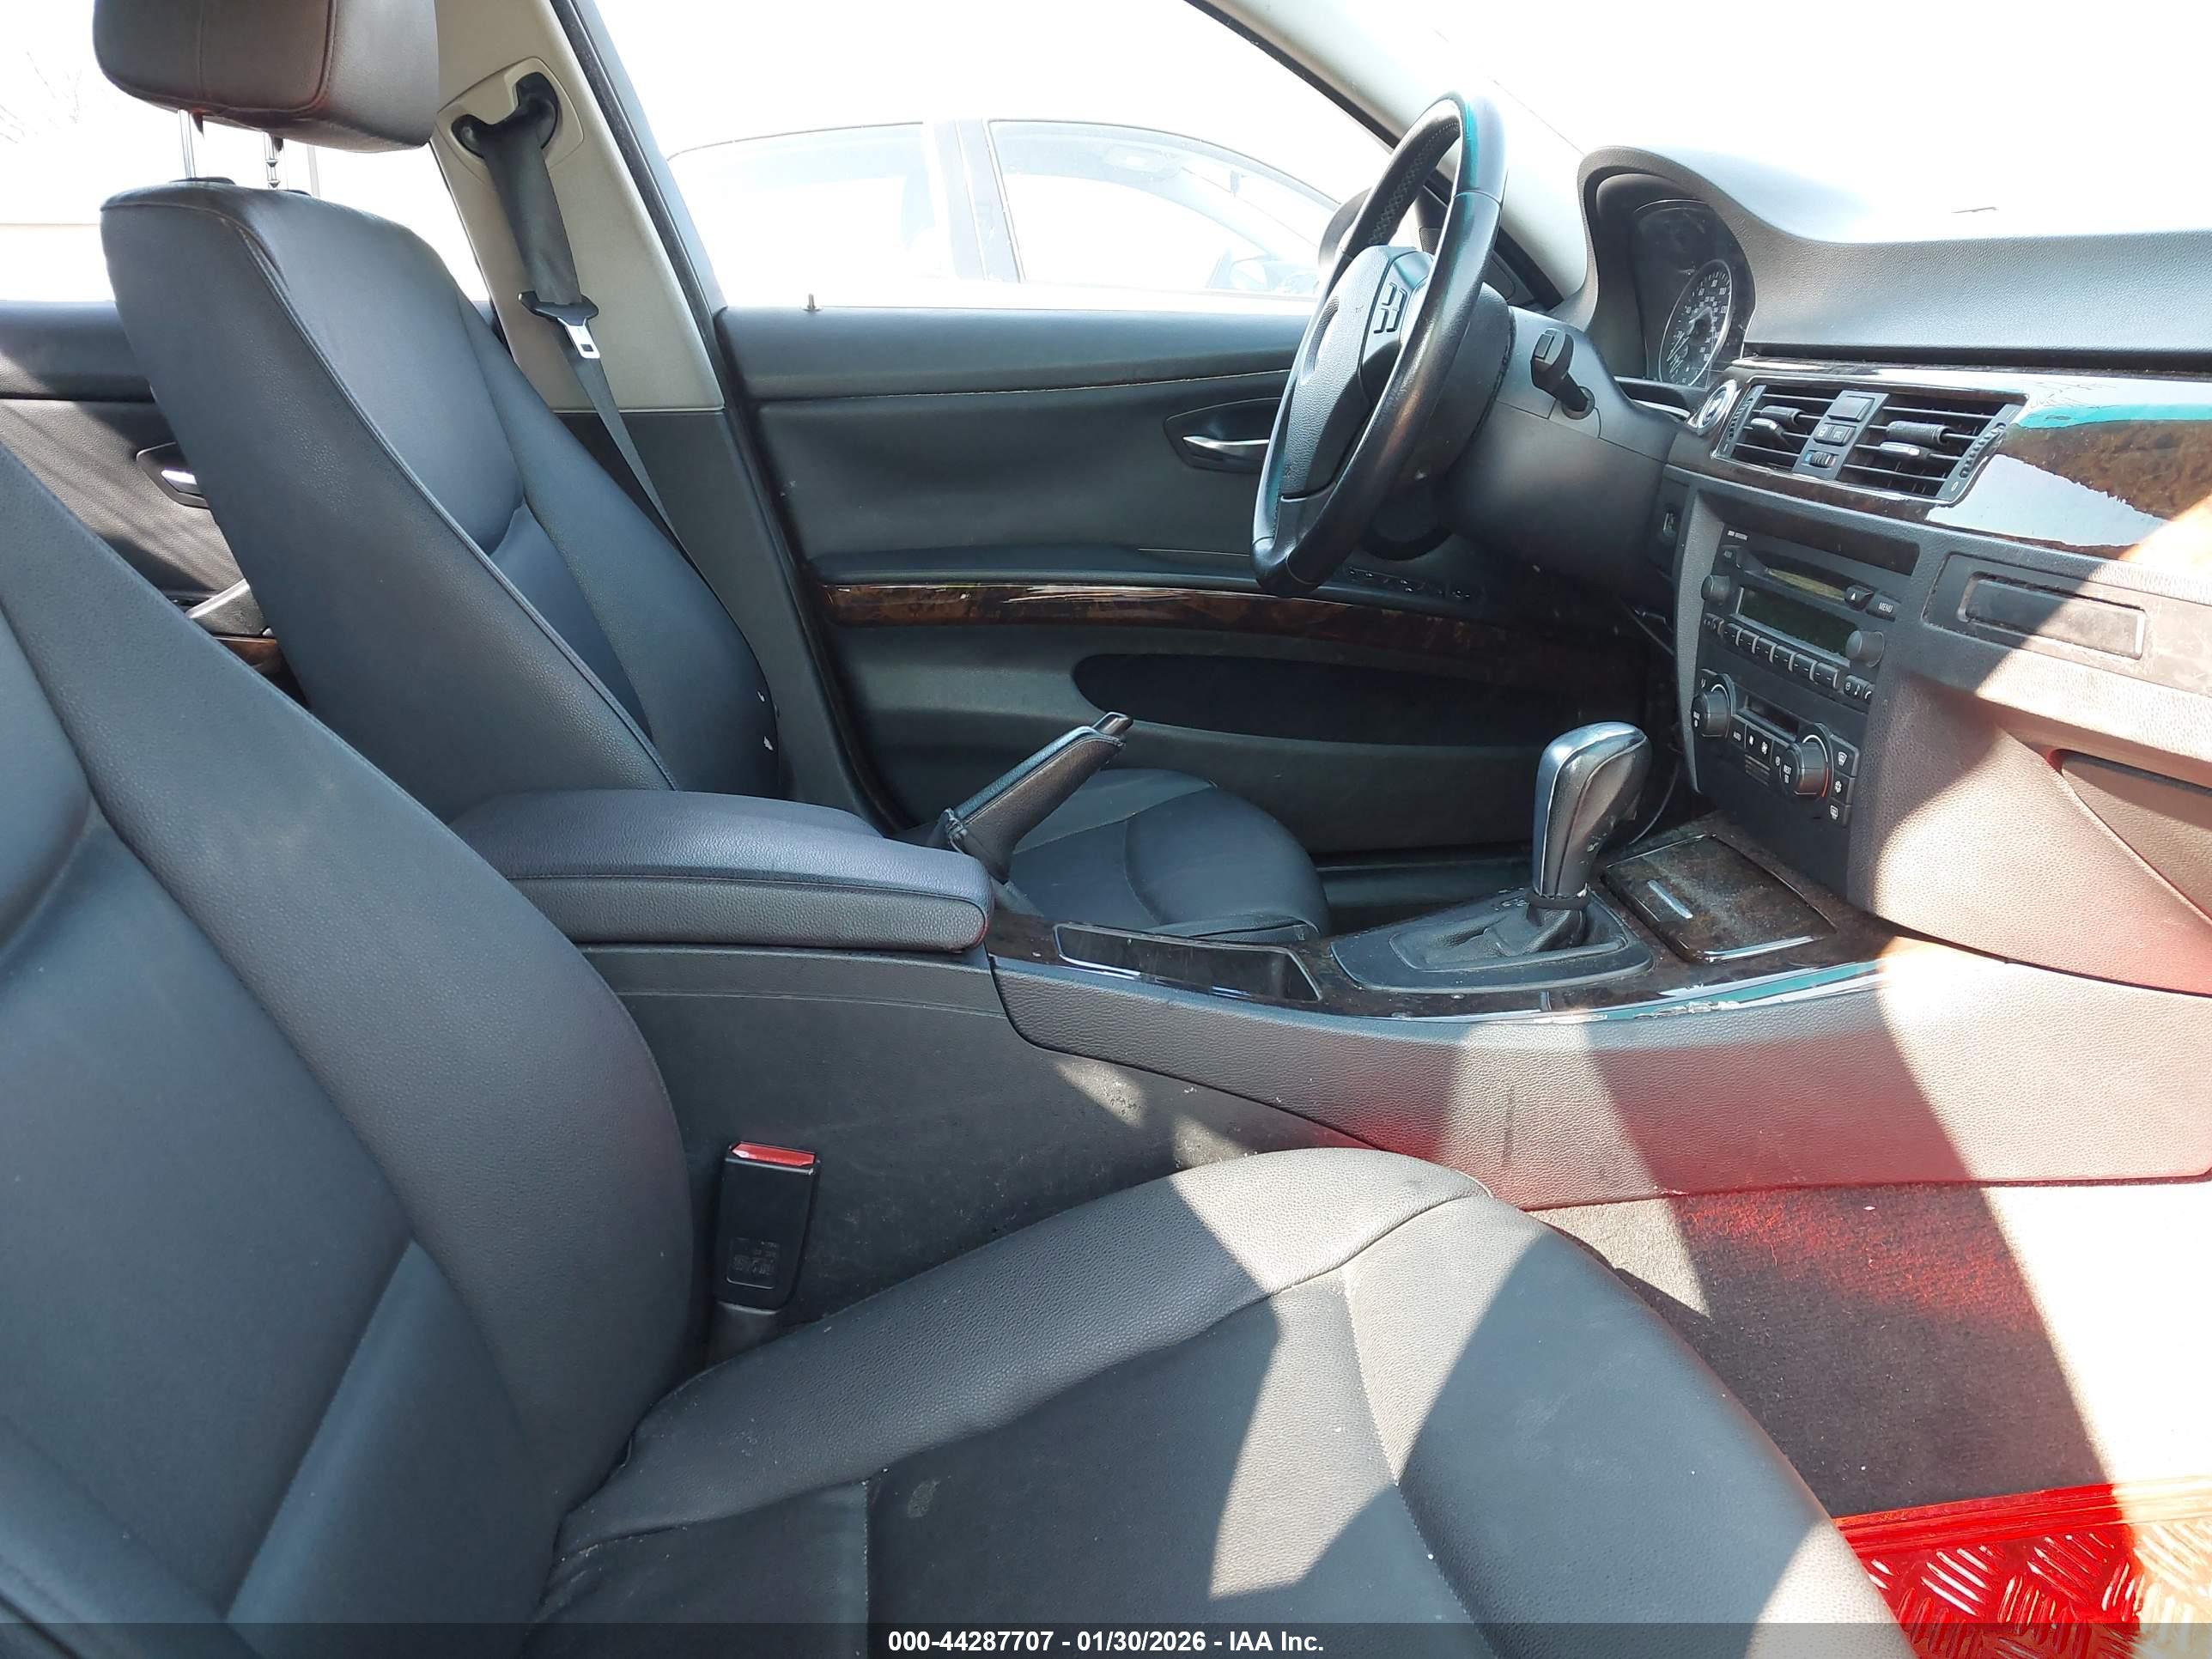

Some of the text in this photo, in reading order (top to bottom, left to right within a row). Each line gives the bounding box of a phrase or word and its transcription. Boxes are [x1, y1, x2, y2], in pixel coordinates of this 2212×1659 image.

[1878, 602, 1893, 613] MENU
[1733, 731, 1741, 741] AUTO
[1783, 764, 1792, 775] REST
